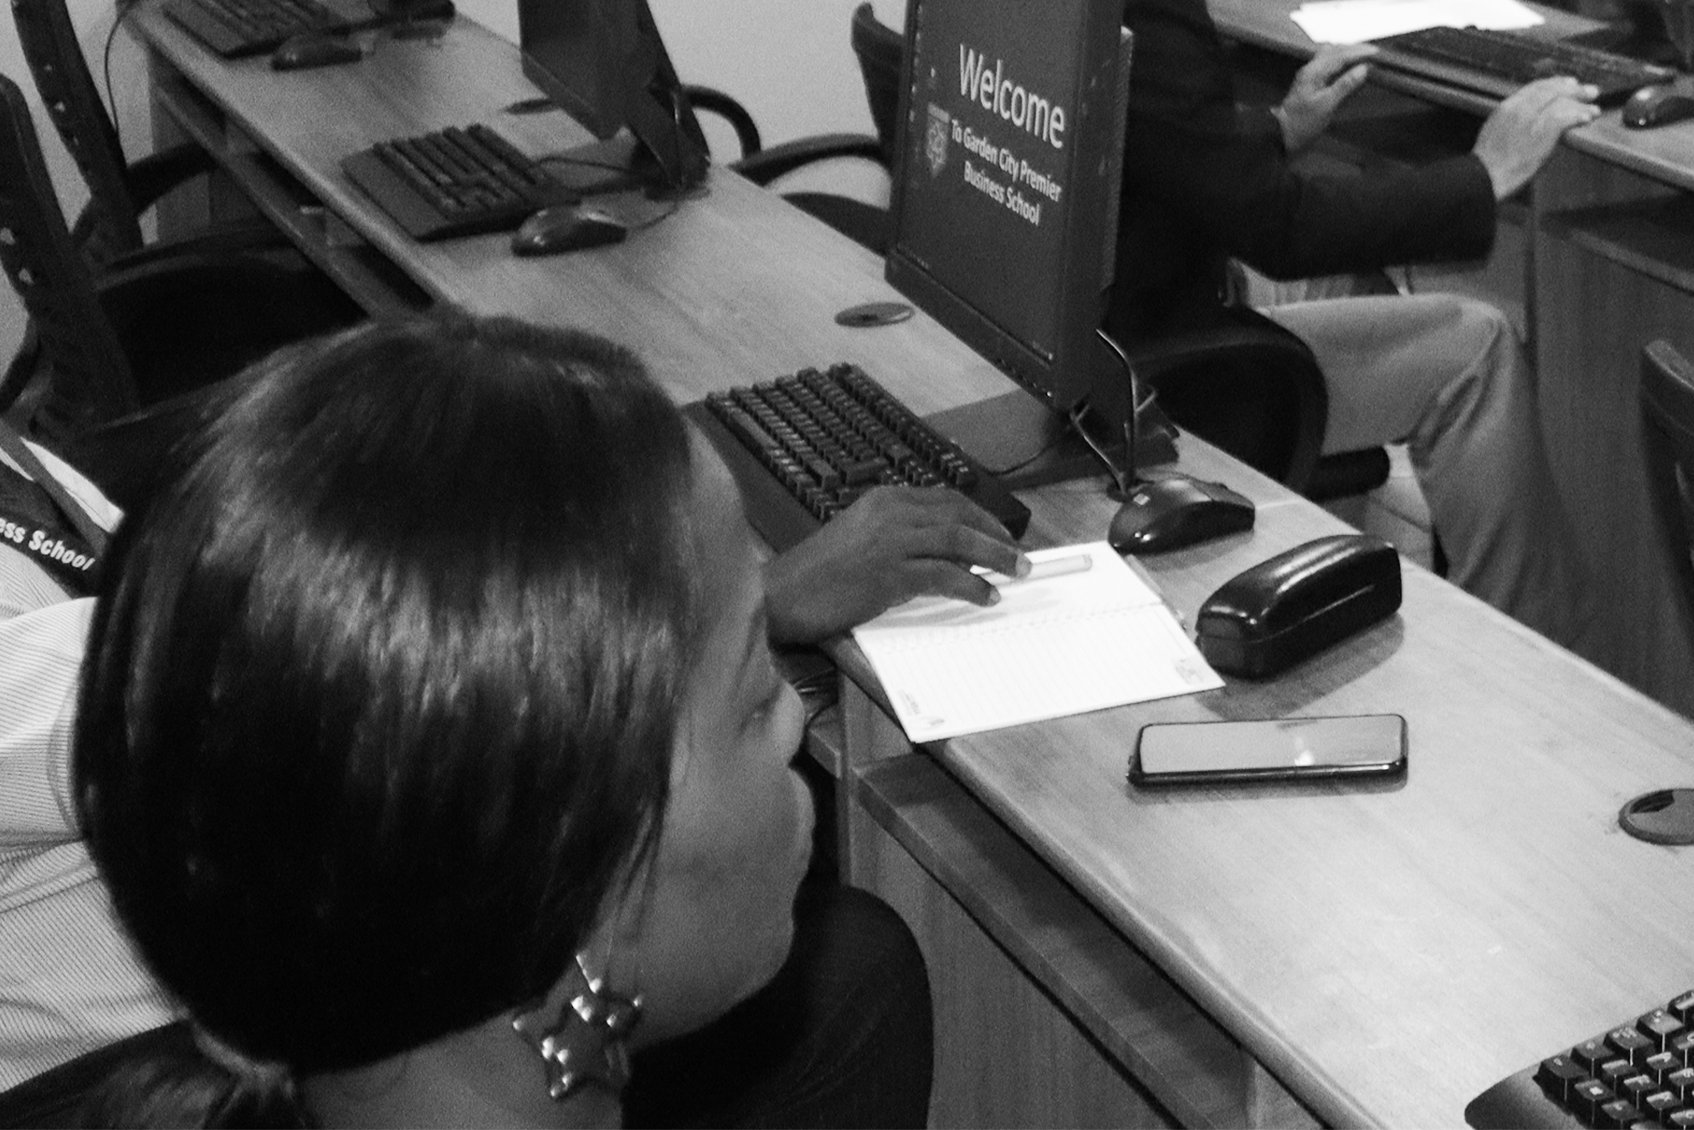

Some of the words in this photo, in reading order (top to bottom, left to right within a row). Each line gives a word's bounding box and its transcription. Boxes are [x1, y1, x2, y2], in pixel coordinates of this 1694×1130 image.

[959, 43, 1065, 149] Welcome
[952, 119, 962, 143] To
[963, 127, 998, 165] Garden
[999, 148, 1019, 183] City
[1020, 160, 1062, 202] Premier
[964, 160, 1005, 204] Business
[1006, 186, 1040, 226] School
[28, 530, 95, 571] School
